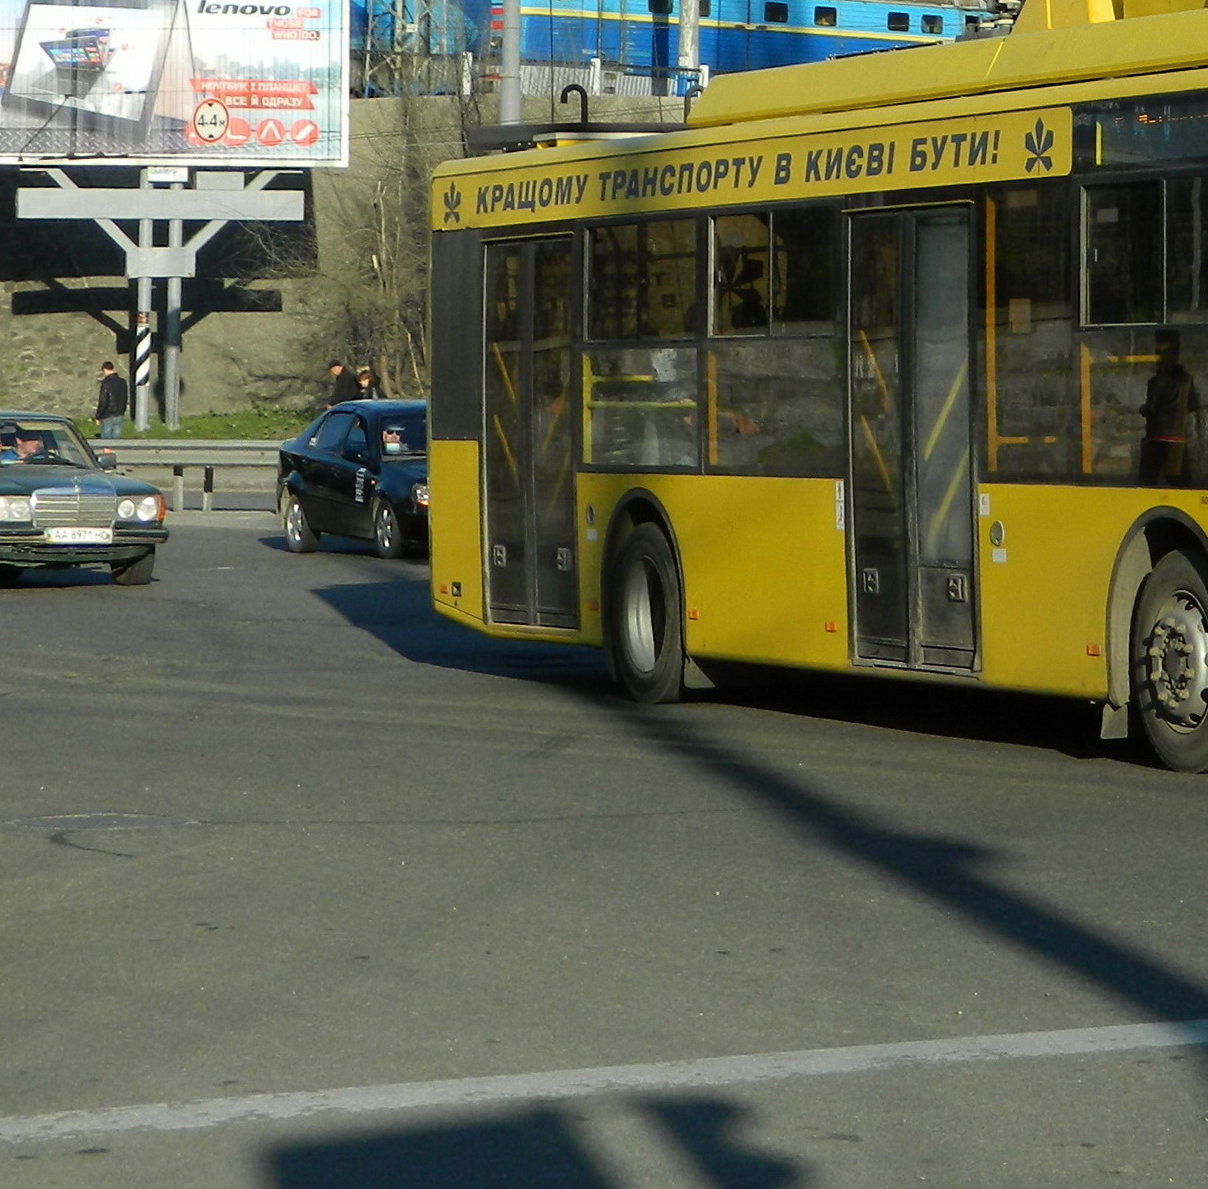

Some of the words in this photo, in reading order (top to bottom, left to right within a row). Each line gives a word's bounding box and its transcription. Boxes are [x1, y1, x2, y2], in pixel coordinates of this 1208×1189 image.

[197, 0, 291, 16] lenovo
[298, 9, 319, 18] FOR
[268, 19, 303, 29] THOSE
[274, 30, 298, 40] WHO
[301, 31, 320, 40] DO.
[201, 81, 248, 91] НОУТБУК
[258, 82, 308, 91] ПЛАНШЕТ
[225, 96, 248, 106] ВСЕ
[251, 94, 259, 106] Й
[262, 96, 304, 107] ОДРАЗУ
[476, 174, 589, 214] КРАЩОМУ
[599, 155, 764, 202] ТРАНСПОРТУ
[774, 153, 793, 185] В
[804, 141, 896, 183] КИЄВІ
[909, 129, 1001, 172] БУТИ!
